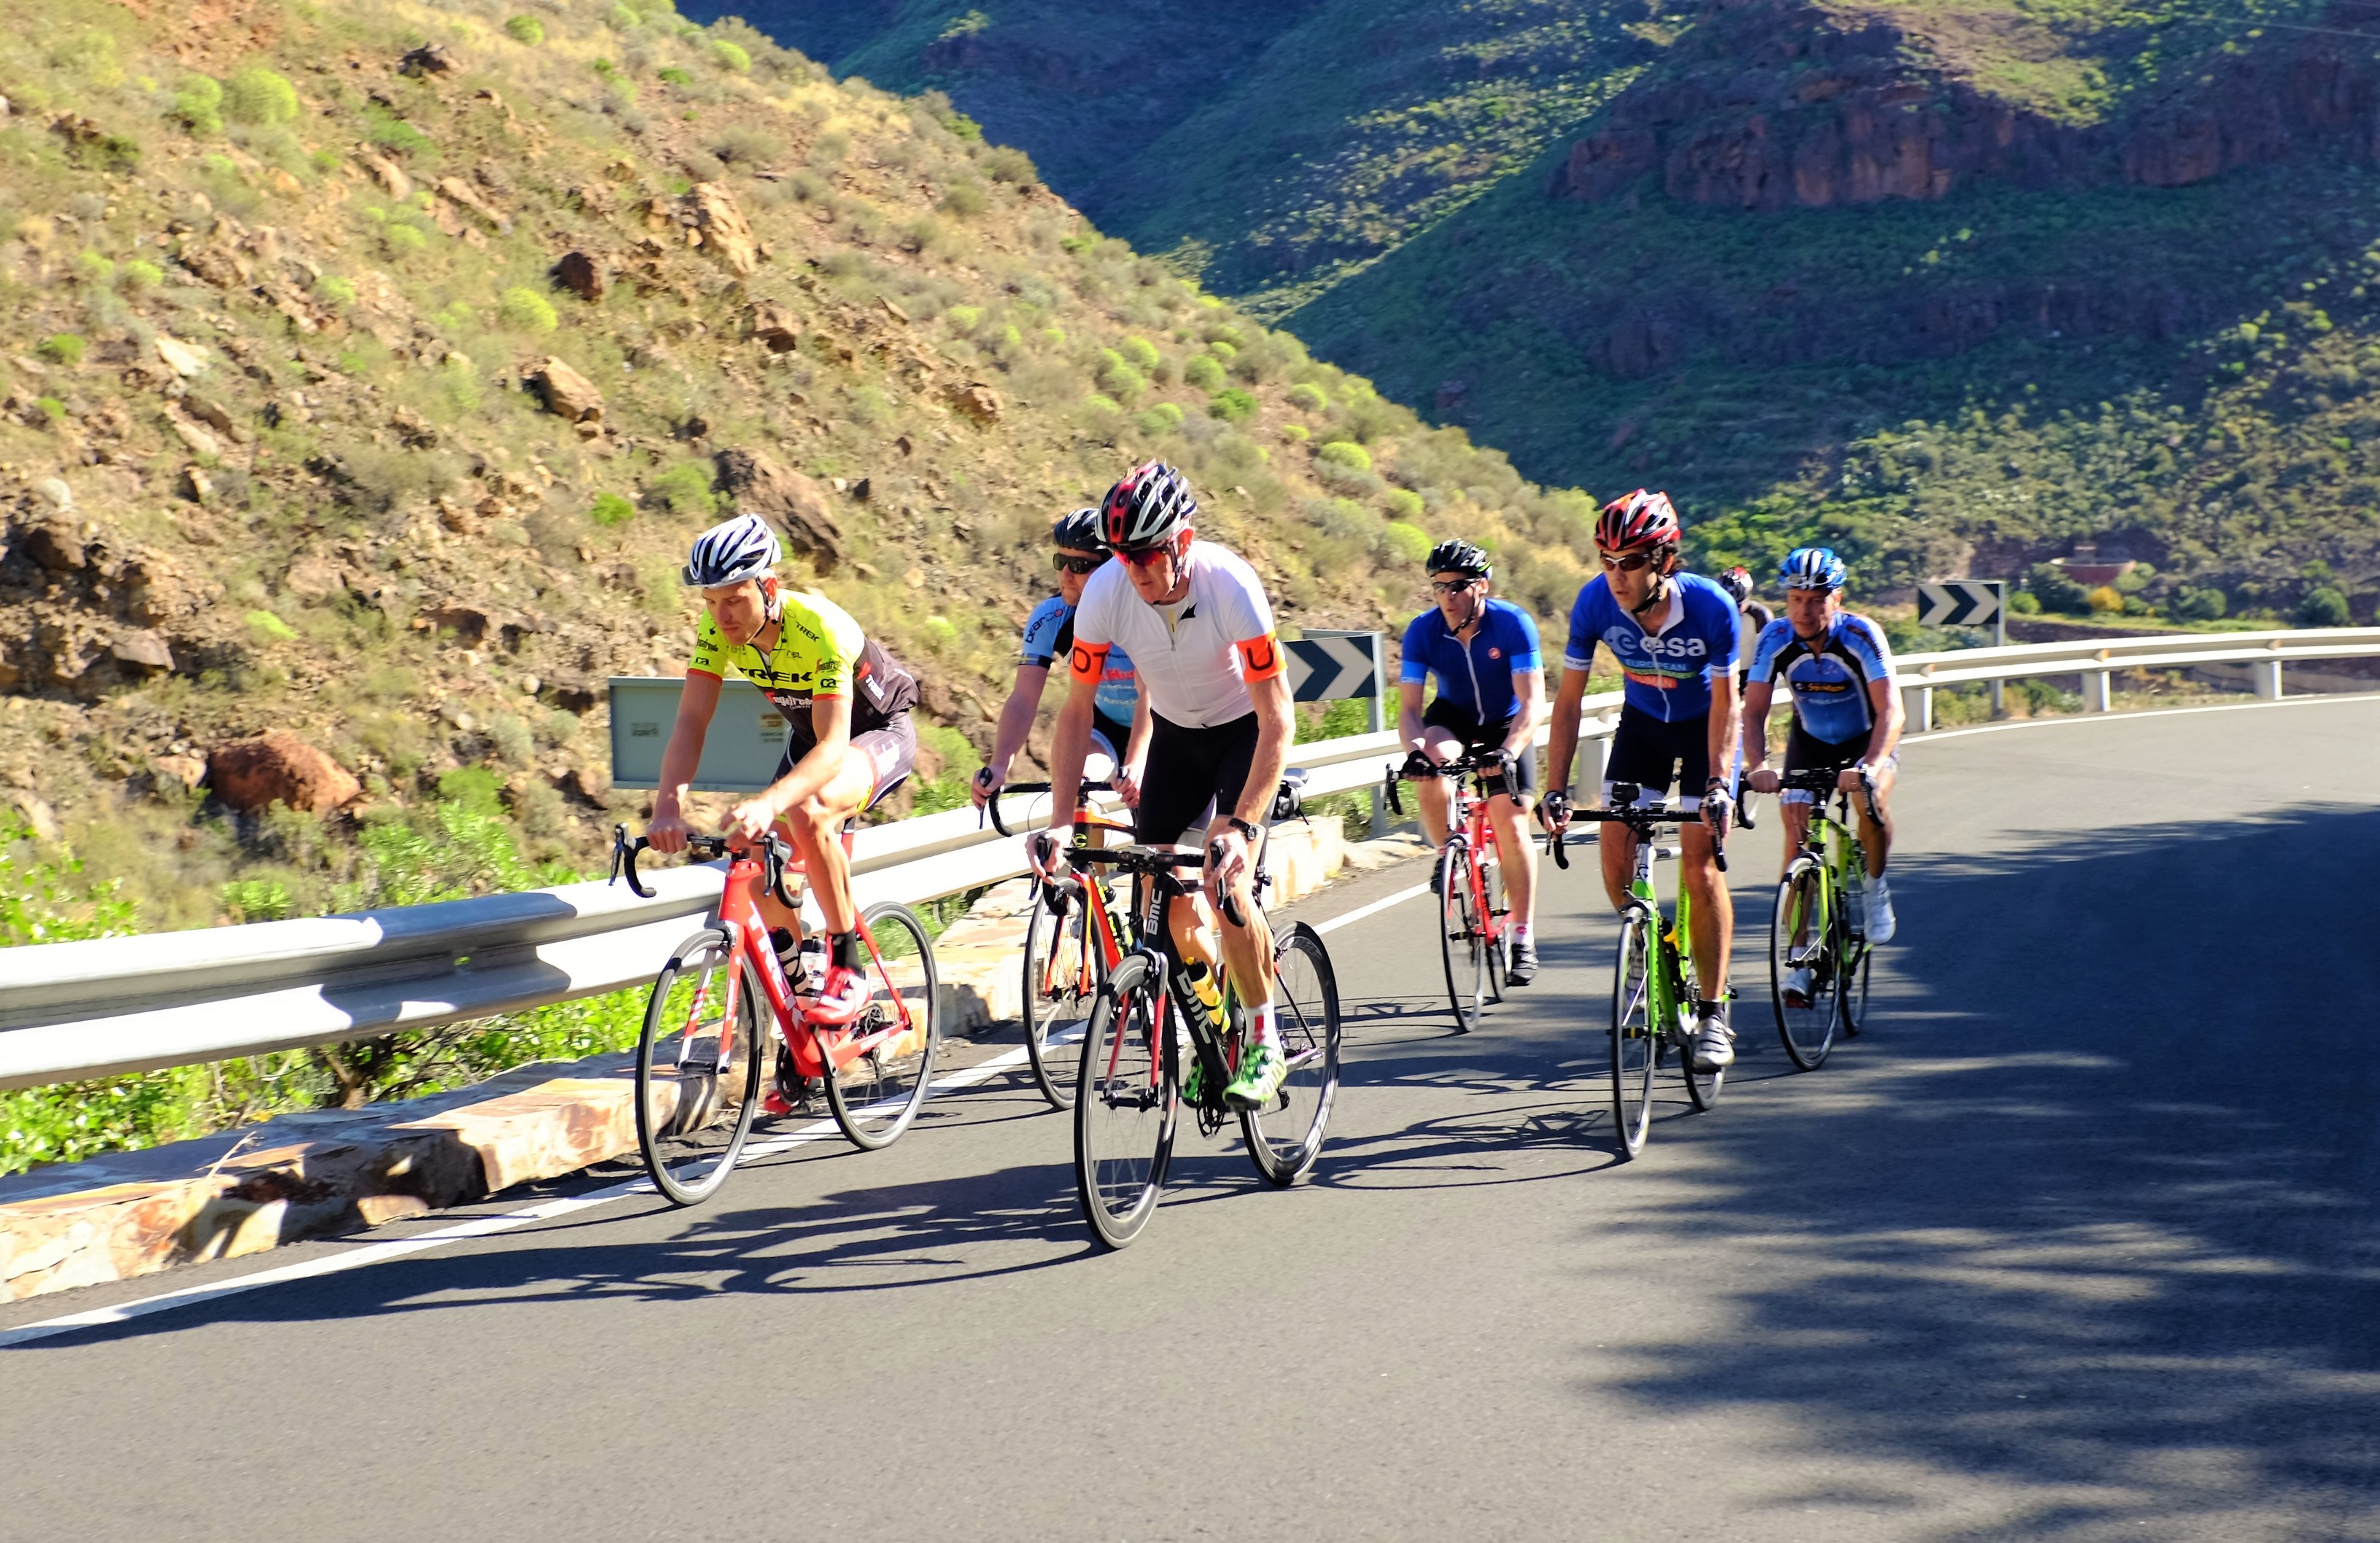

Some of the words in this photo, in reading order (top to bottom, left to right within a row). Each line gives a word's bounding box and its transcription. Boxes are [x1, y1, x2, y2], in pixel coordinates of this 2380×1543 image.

[795, 621, 820, 642] TREK
[1640, 630, 1708, 657] esa
[1146, 887, 1163, 936] BMC
